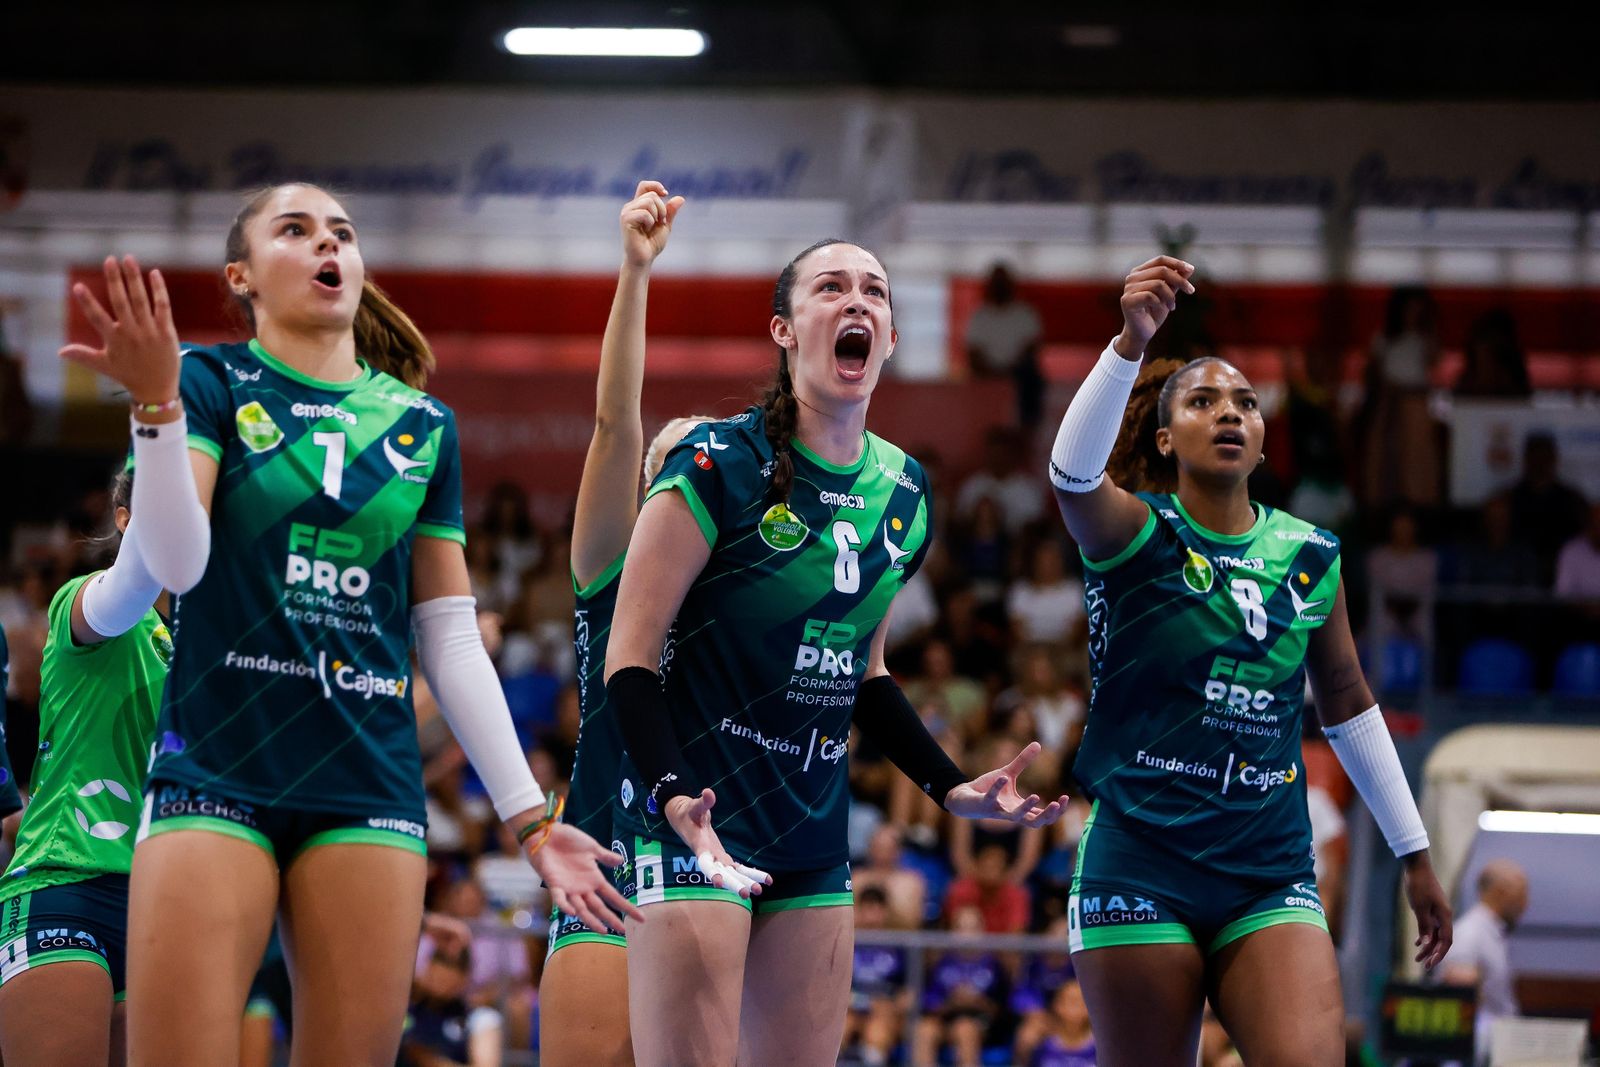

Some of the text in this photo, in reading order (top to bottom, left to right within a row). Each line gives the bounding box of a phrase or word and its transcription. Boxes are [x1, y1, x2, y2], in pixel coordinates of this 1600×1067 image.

[289, 522, 364, 559] FP
[832, 519, 862, 595] 6
[285, 553, 371, 598] PRO
[1230, 578, 1268, 642] 8
[802, 618, 857, 646] FP
[789, 674, 857, 691] FORMACIÓN
[1209, 654, 1274, 683] FP
[786, 690, 856, 707] PROFESION
[1204, 679, 1275, 713] PRO
[1202, 715, 1281, 739] PROFESIONAL
[1136, 750, 1298, 792] Fundación Cajasol
[643, 865, 655, 890] 6
[1083, 895, 1155, 914] MAX
[1085, 910, 1158, 925] COLCHON
